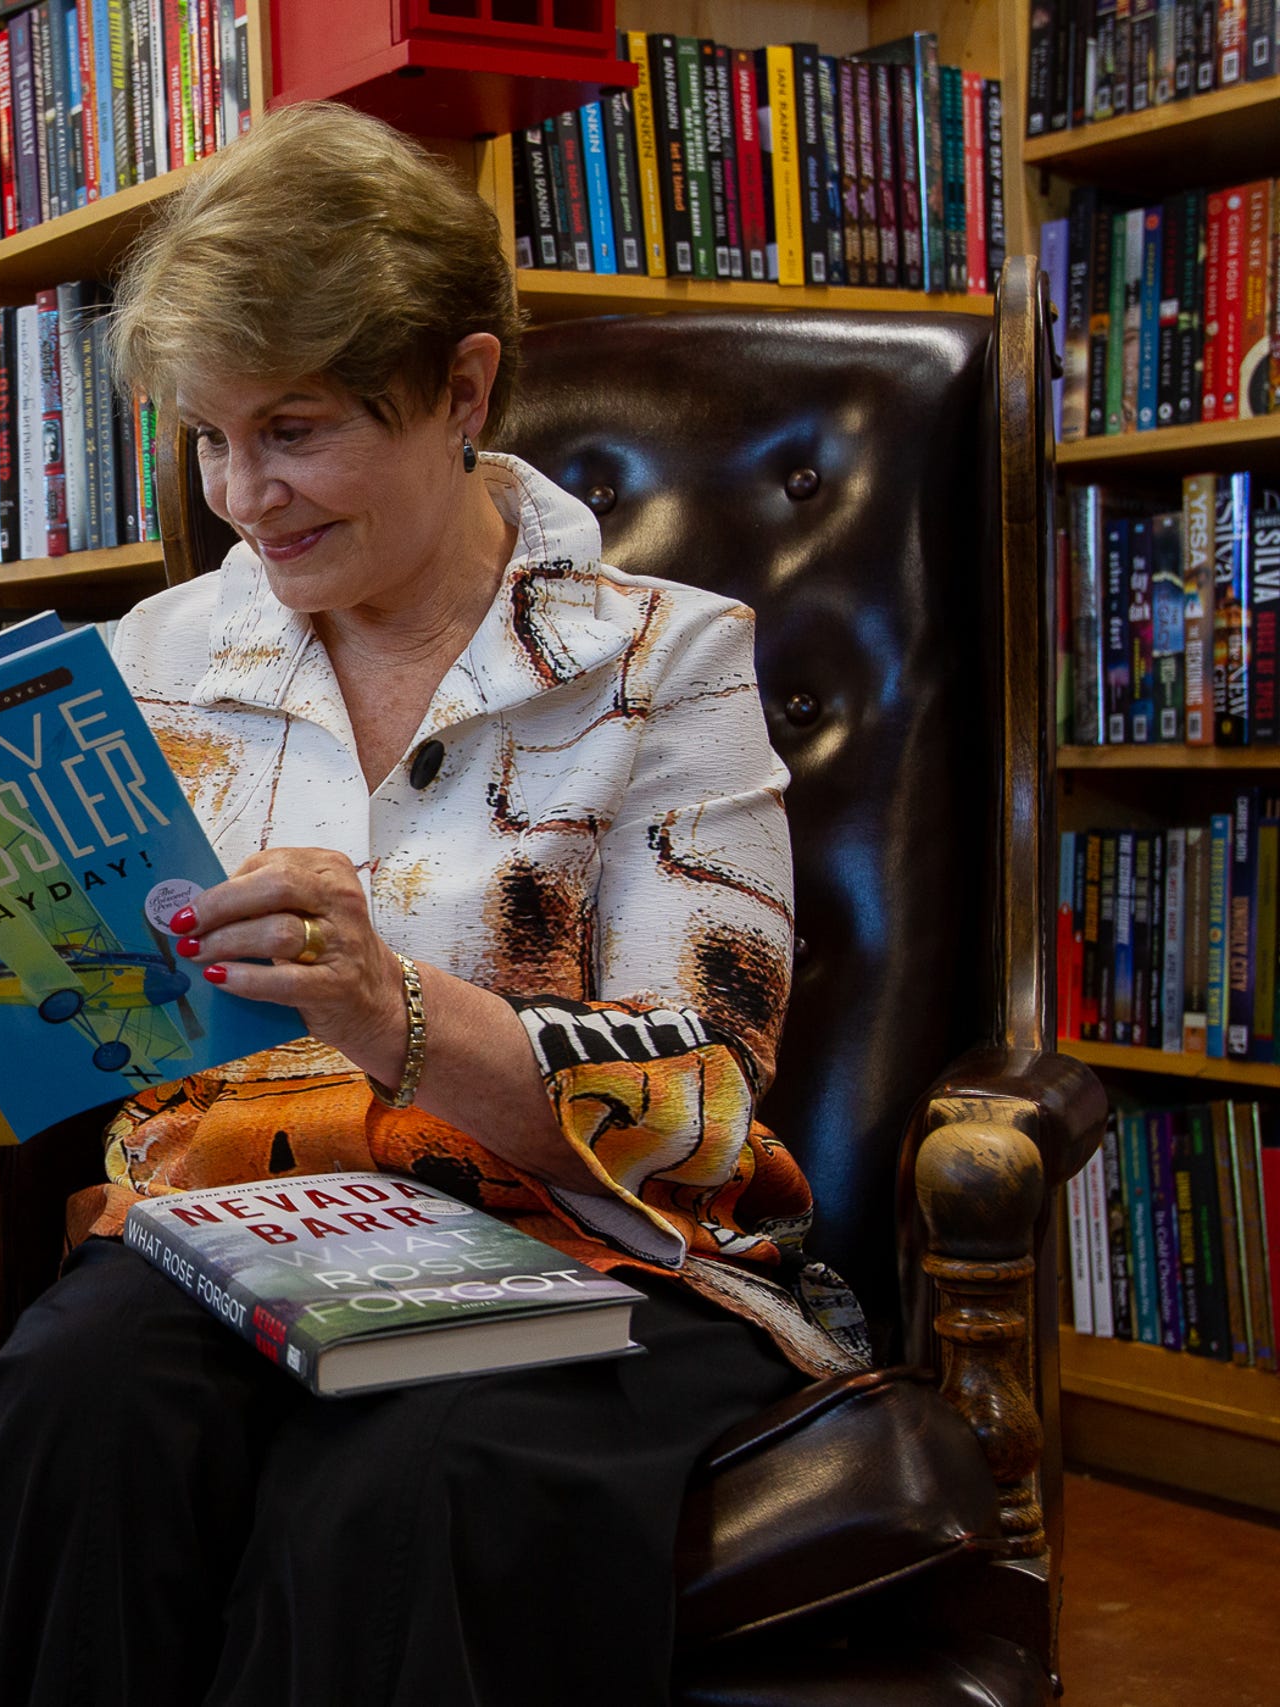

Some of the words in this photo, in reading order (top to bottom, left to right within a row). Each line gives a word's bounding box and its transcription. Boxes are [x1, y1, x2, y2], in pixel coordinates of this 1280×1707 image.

[201, 26, 210, 70] Caught
[663, 57, 674, 78] IAN
[171, 65, 179, 88] THE
[704, 66, 715, 86] IAN
[717, 66, 727, 87] IAN
[739, 69, 750, 91] IAN
[777, 68, 786, 96] IAN
[803, 72, 814, 94] IAN
[18, 80, 33, 156] CONNOLLY
[173, 91, 181, 120] GRAY
[203, 73, 213, 124] Stealing
[665, 81, 679, 129] RANKIN
[688, 64, 699, 111] STANDING
[695, 128, 705, 172] ANOTHER
[719, 90, 731, 138] RANKIN
[740, 93, 753, 141] RANKIN
[174, 123, 182, 148] MAN
[639, 94, 652, 158] RANKIN
[705, 90, 721, 152] RANKIN
[779, 102, 790, 162] RANKIN
[805, 96, 816, 144] RANKIN
[989, 97, 1001, 141] COLD
[58, 129, 66, 168] CALLED
[87, 140, 95, 180] LAWSON
[531, 152, 544, 174] IAN
[670, 142, 681, 159] let
[672, 162, 681, 172] it
[990, 145, 1002, 178] DAY
[568, 165, 579, 198] black
[673, 177, 684, 211] bleed
[536, 178, 551, 228] RANKIN
[691, 200, 700, 236] RANKIN
[992, 199, 1003, 241] HELL
[1250, 191, 1263, 233] LISA
[1249, 237, 1262, 269] SEE
[1071, 262, 1088, 329] BLACK
[99, 368, 113, 517] FOUNDRYSIDE
[141, 410, 151, 450] EDGAR
[143, 452, 153, 508] CANTERO
[1190, 493, 1208, 568] YRSA
[1186, 640, 1204, 707] RECKONING
[1228, 663, 1249, 720] NEW
[1231, 896, 1249, 954] UNHOLY
[1231, 957, 1248, 992] CITY
[156, 1197, 184, 1206] NEW
[189, 1192, 221, 1200] YORK
[225, 1186, 261, 1195] TIMES
[264, 1176, 344, 1191] BESTSELLING
[169, 1182, 439, 1227] NEVADA
[246, 1206, 438, 1245] BARR
[269, 1228, 475, 1268] WHAT
[128, 1218, 162, 1259] WHAT
[162, 1247, 195, 1289] ROSE
[196, 1273, 247, 1329] FORGOT
[313, 1250, 513, 1290] ROSE
[303, 1269, 586, 1324] FORGOT
[462, 1300, 497, 1309] NOVEL
[252, 1304, 287, 1345] NEVADA
